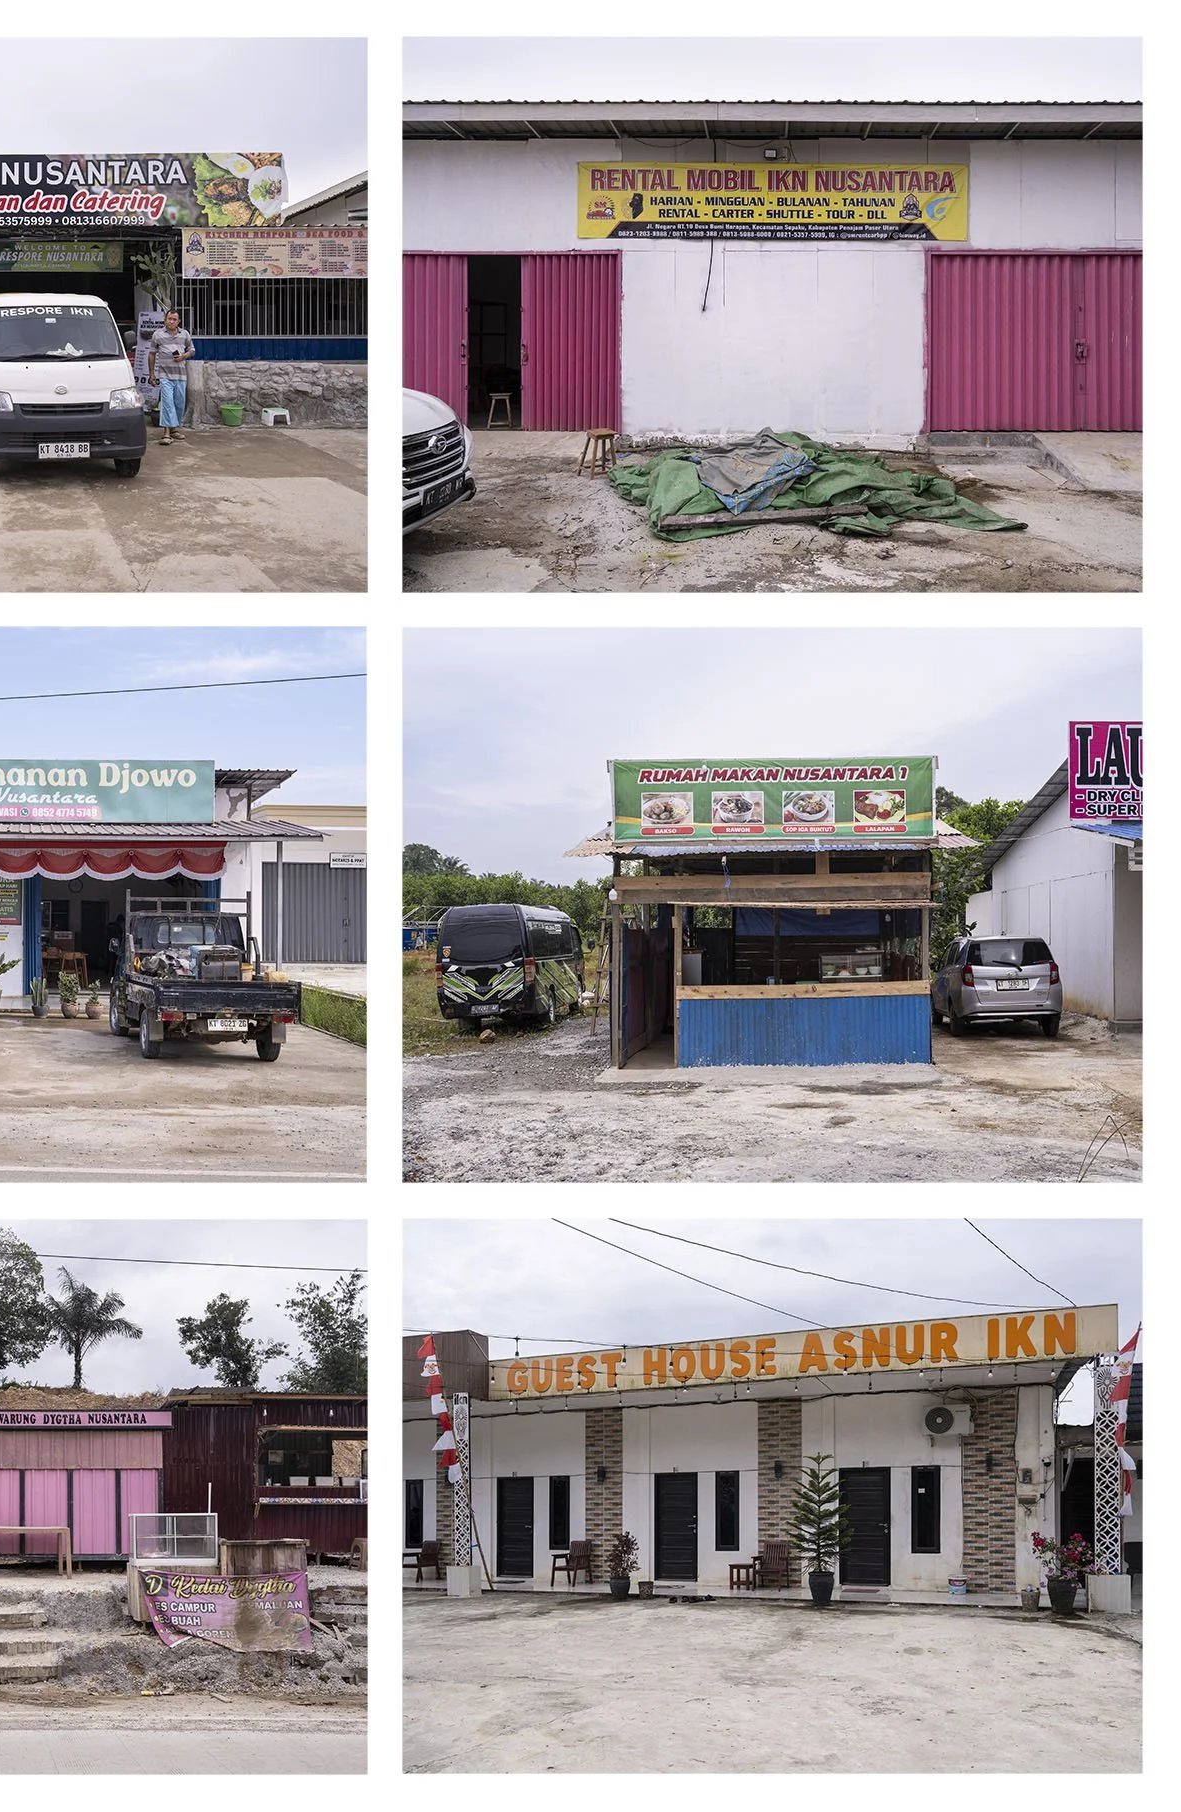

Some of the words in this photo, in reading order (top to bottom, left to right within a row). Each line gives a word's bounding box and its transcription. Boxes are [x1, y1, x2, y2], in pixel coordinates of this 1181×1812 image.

[1, 160, 188, 186] NUSANTARA
[590, 168, 681, 191] RENTAL
[687, 168, 762, 192] MOBIL
[767, 169, 808, 192] IKN
[814, 170, 956, 193] NUSANTARA
[21, 189, 68, 213] dan
[70, 188, 167, 219] Catering
[650, 196, 694, 206] HARIAN
[705, 196, 765, 207] MINGGUAN
[776, 197, 830, 207] BULANAN
[841, 197, 896, 207] TAHUNAN
[658, 208, 700, 218] RENTAL
[712, 209, 754, 219] CARTER
[766, 209, 814, 219] SHUTTLE
[825, 209, 855, 219] TOUR
[867, 210, 887, 219] DLL
[61, 215, 145, 226] 081316607999
[0, 251, 43, 262] RESPORE
[46, 251, 104, 262] NUSANTARA
[0, 307, 63, 318] RESPORE
[70, 307, 94, 317] IKN
[40, 445, 50, 454] KT
[54, 444, 75, 454] 8418
[98, 761, 197, 794] Djowo
[637, 767, 709, 785] RUMAH
[710, 767, 780, 783] MAKAN
[782, 766, 895, 782] NUSANTARA
[898, 765, 908, 781] 1
[1086, 789, 1119, 803] DRY
[1120, 790, 1143, 803] CL
[32, 807, 55, 817] 0852
[1086, 803, 1138, 816] SUPER
[506, 1352, 623, 1395] GUEST
[642, 1338, 777, 1386] HOUSE
[798, 1322, 959, 1374] ASNUR
[987, 1311, 1077, 1361] IKN
[43, 1413, 82, 1425] DYGTHA
[87, 1413, 147, 1424] NUSANTARA
[145, 1574, 163, 1596] D
[171, 1575, 228, 1599] Kedai
[155, 1601, 168, 1611] ES
[170, 1601, 216, 1613] CAMPUR
[171, 1616, 202, 1626] BUAH
